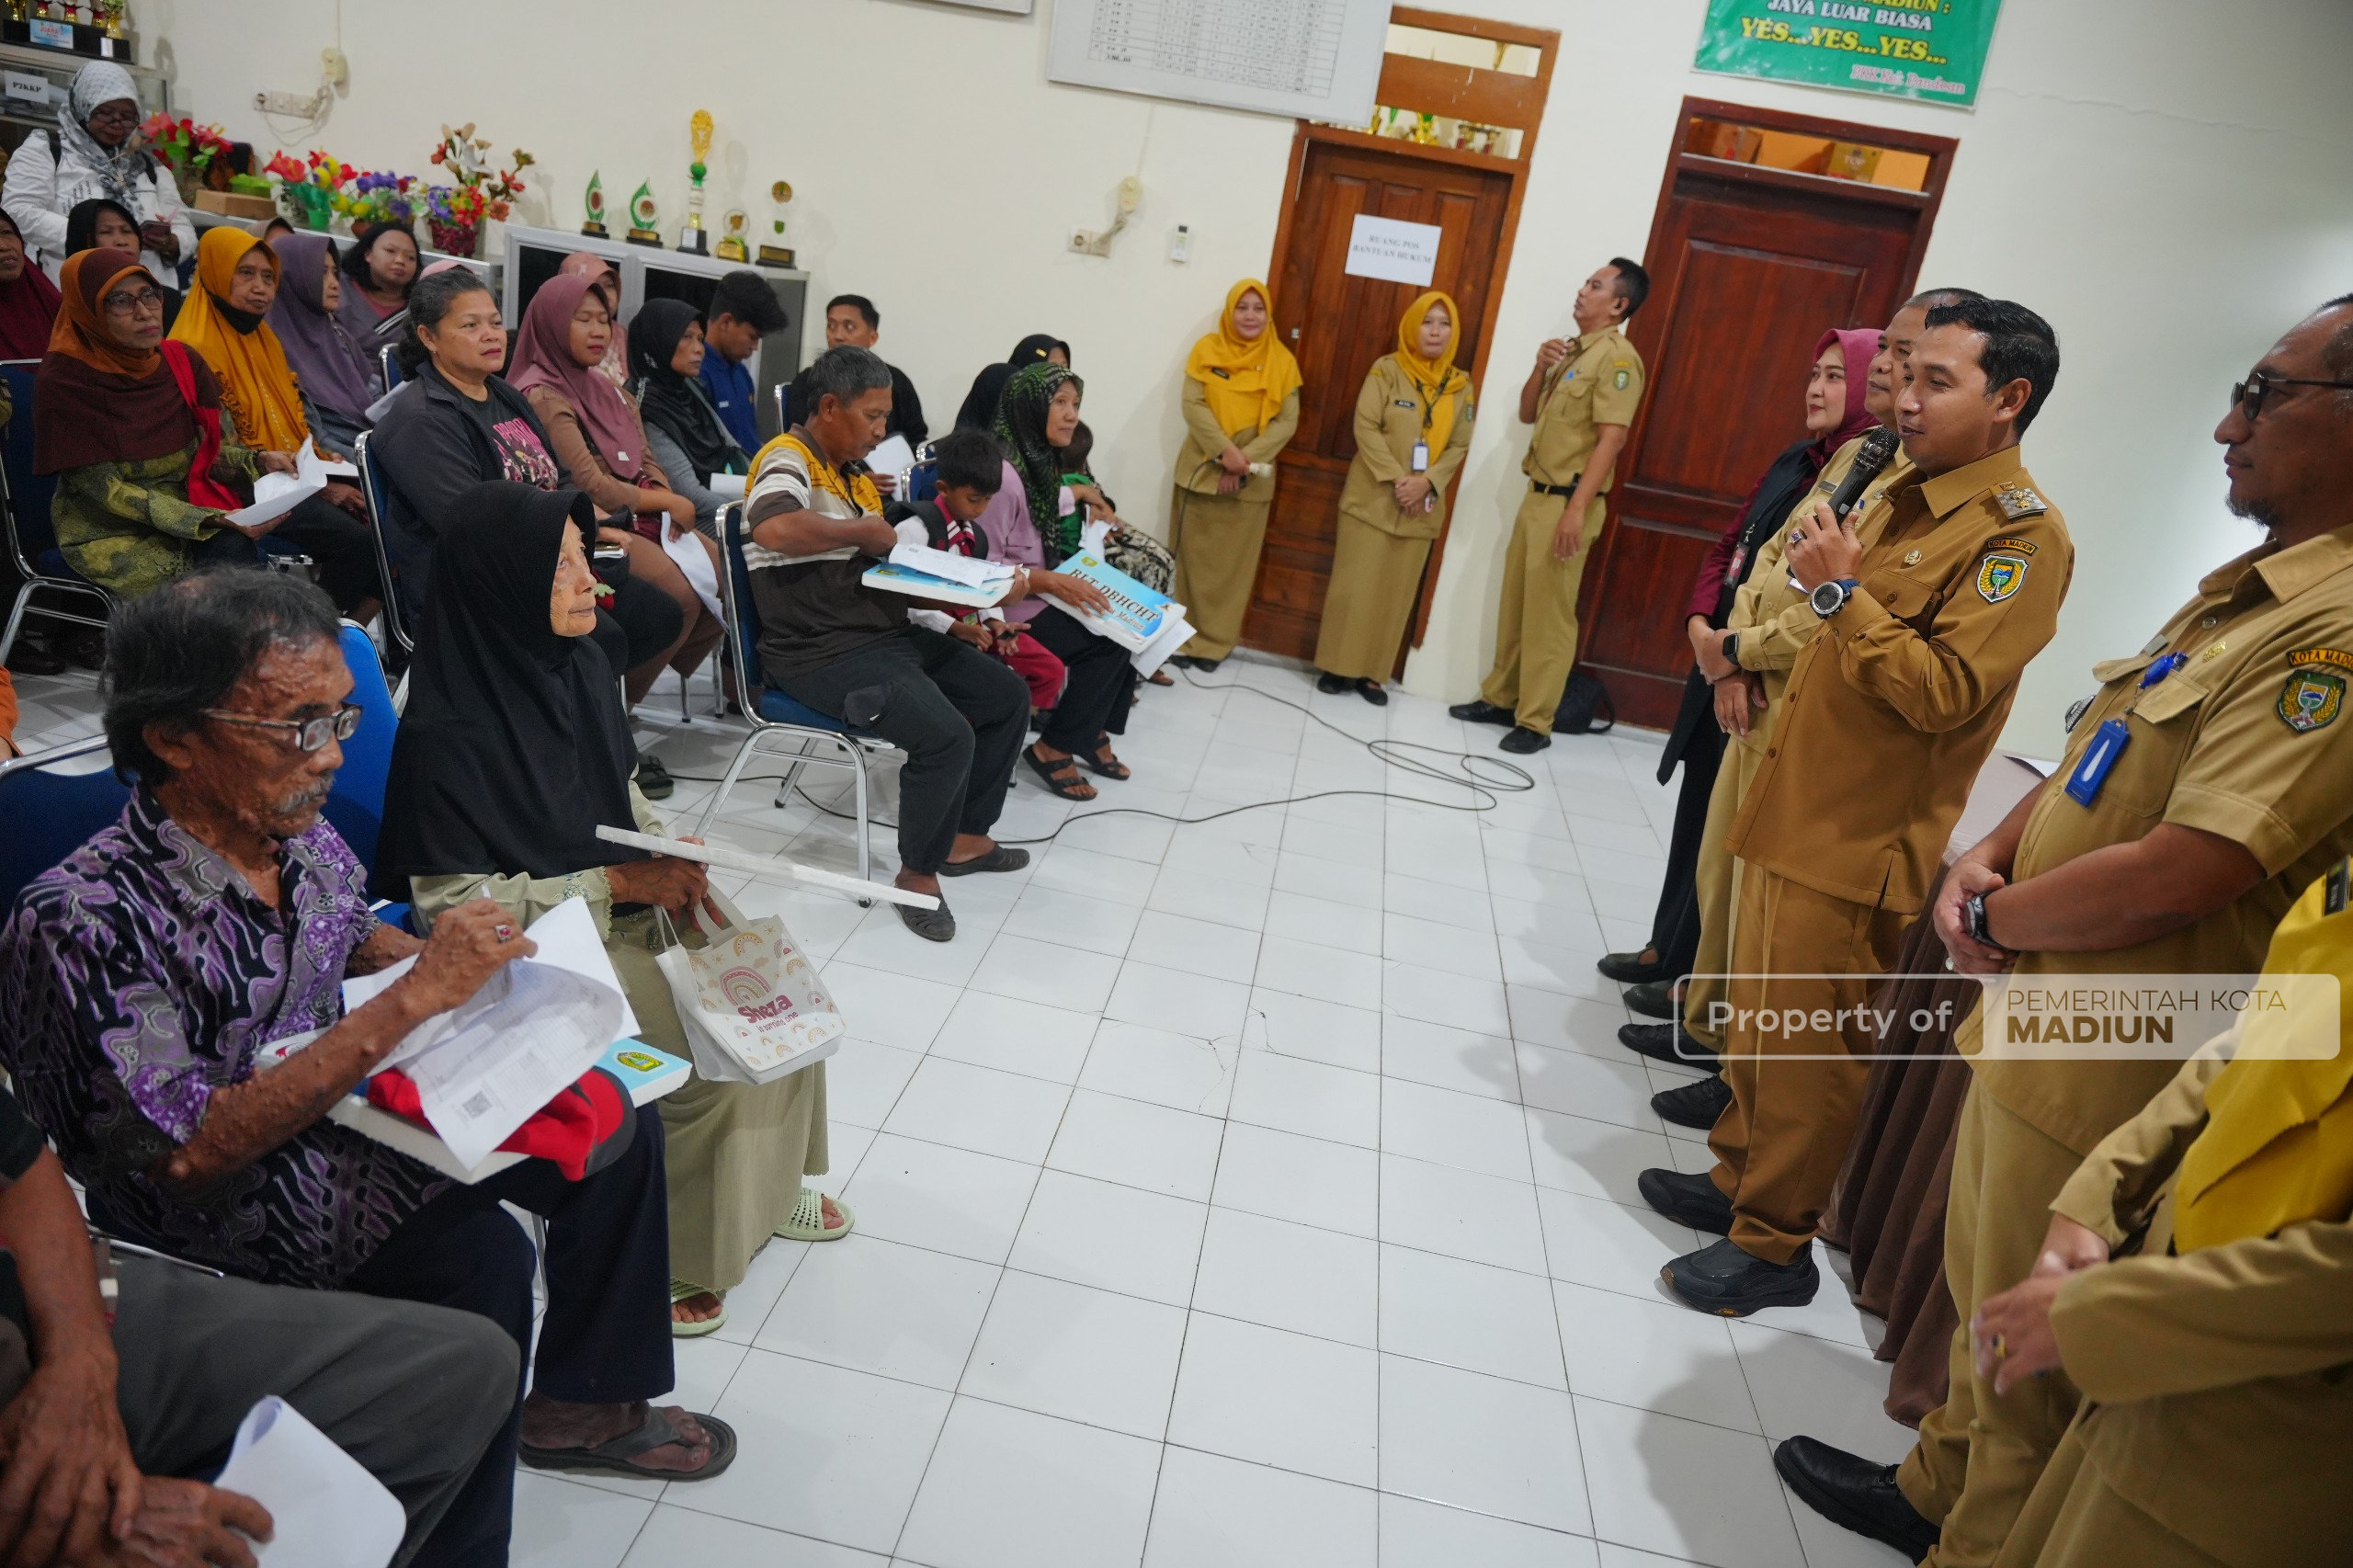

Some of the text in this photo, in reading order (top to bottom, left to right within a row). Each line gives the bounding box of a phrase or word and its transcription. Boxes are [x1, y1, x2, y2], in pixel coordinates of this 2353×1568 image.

[1767, 0, 1932, 30] JAYA LUAR BIASA
[2009, 540, 2034, 552] MADIUN
[1099, 585, 1159, 622] DBHCHT
[2290, 650, 2321, 664] KOTA
[738, 994, 794, 1023] Sheza
[785, 1011, 799, 1023] one
